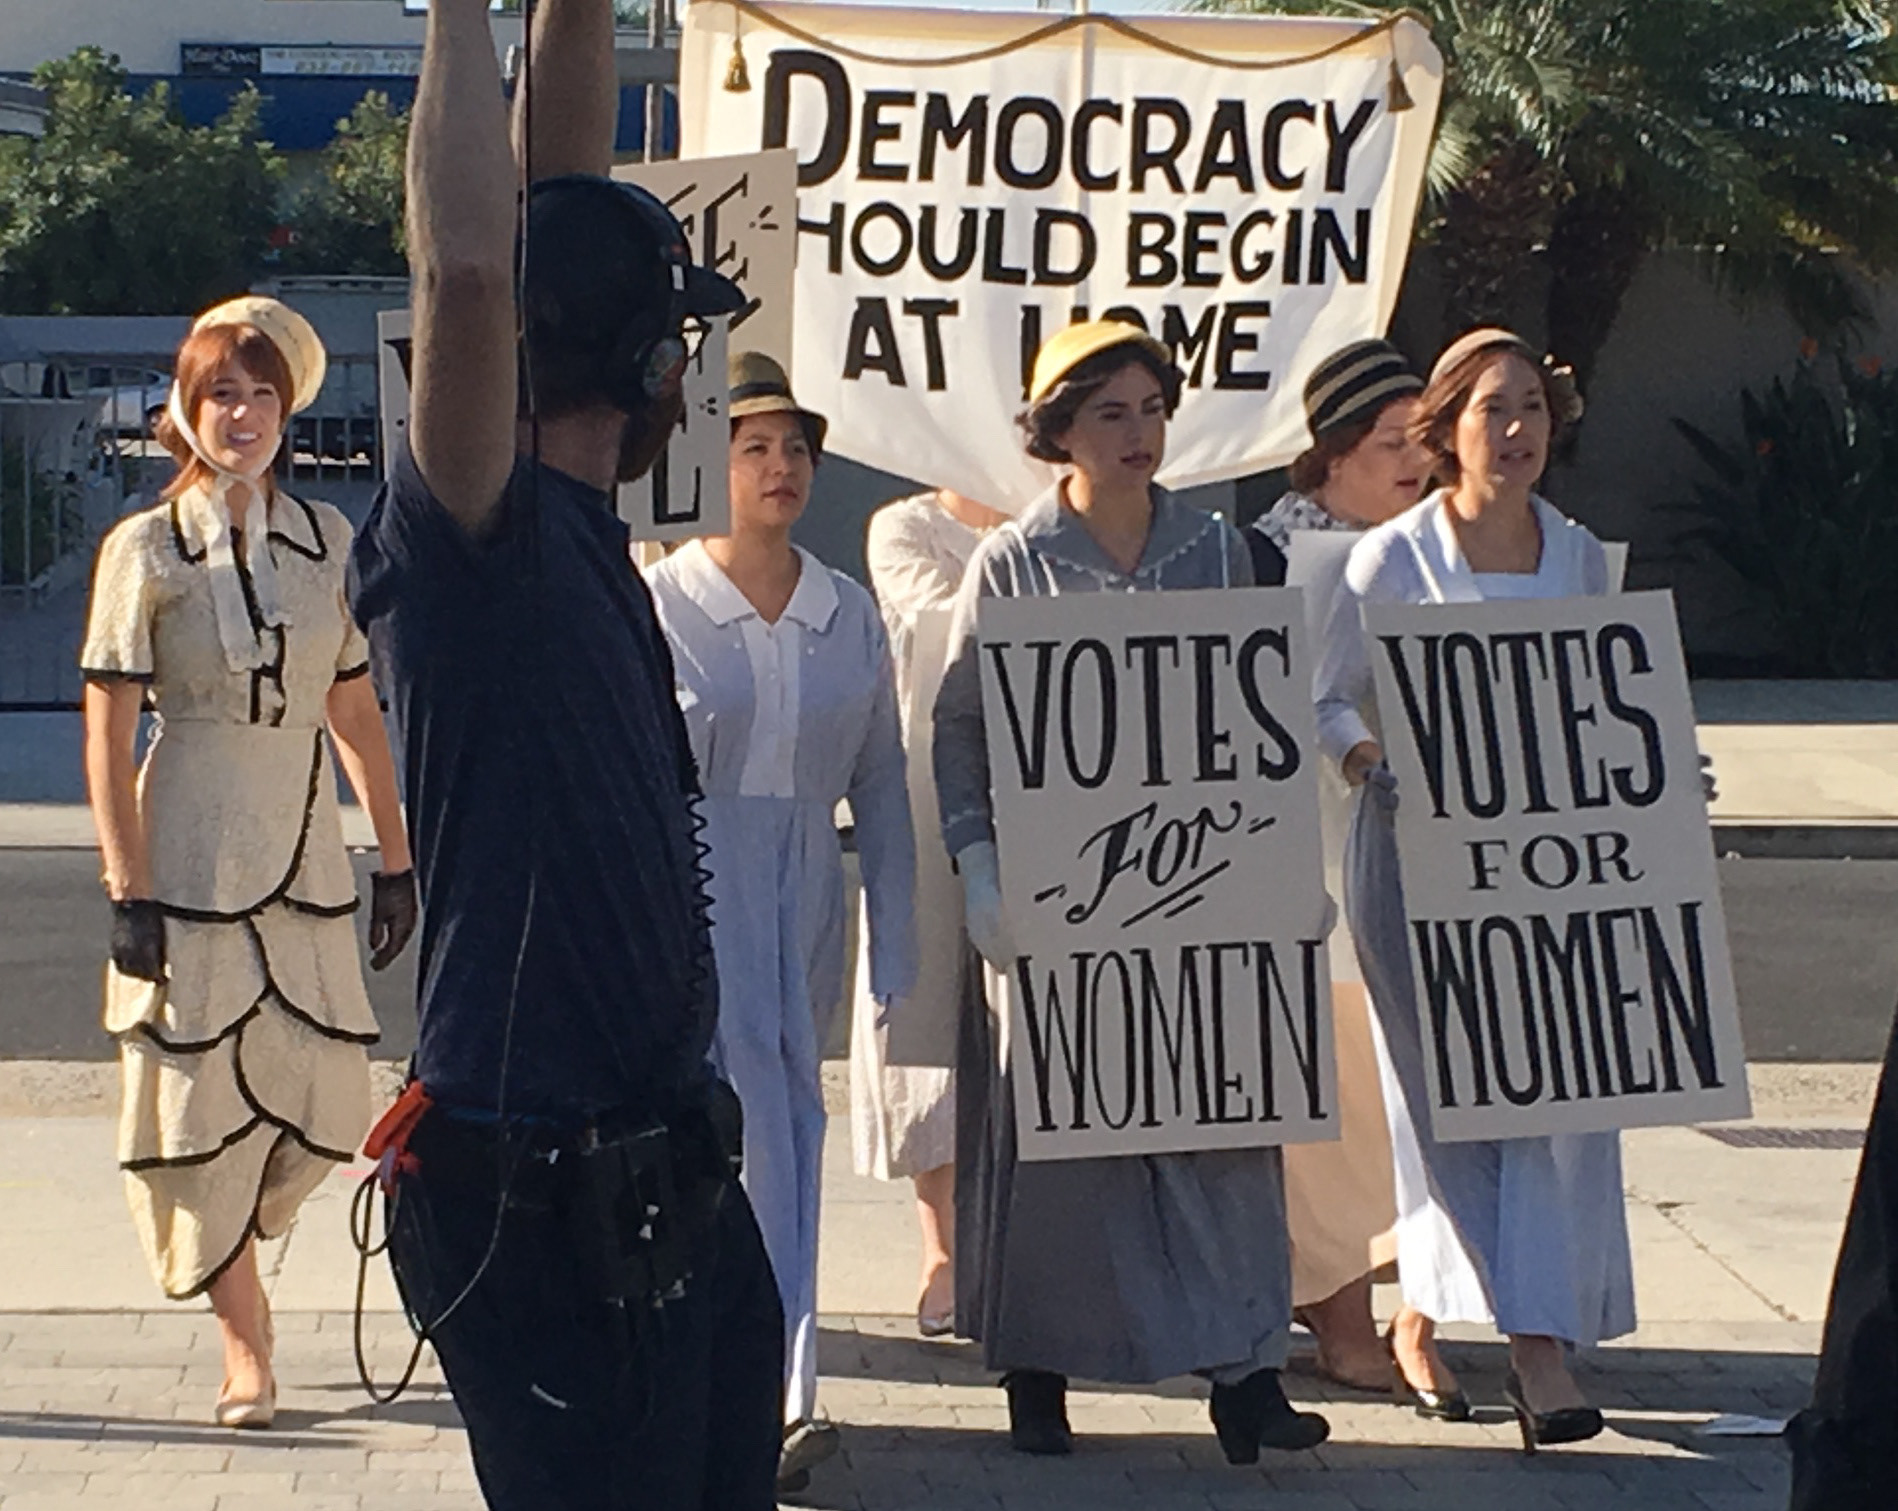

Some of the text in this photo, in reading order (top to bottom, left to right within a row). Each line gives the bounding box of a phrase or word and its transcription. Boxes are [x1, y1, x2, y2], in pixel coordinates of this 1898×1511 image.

[762, 48, 1379, 194] DEMOCRACY
[797, 200, 1097, 286] HOULD
[1126, 208, 1372, 288] BEGIN
[842, 297, 959, 391] AT
[982, 624, 1301, 790] VOTES
[1376, 622, 1667, 820] VOTES
[1464, 830, 1646, 891] FOR
[1015, 938, 1328, 1132] WOMEN
[1410, 901, 1726, 1109] WOMEN
